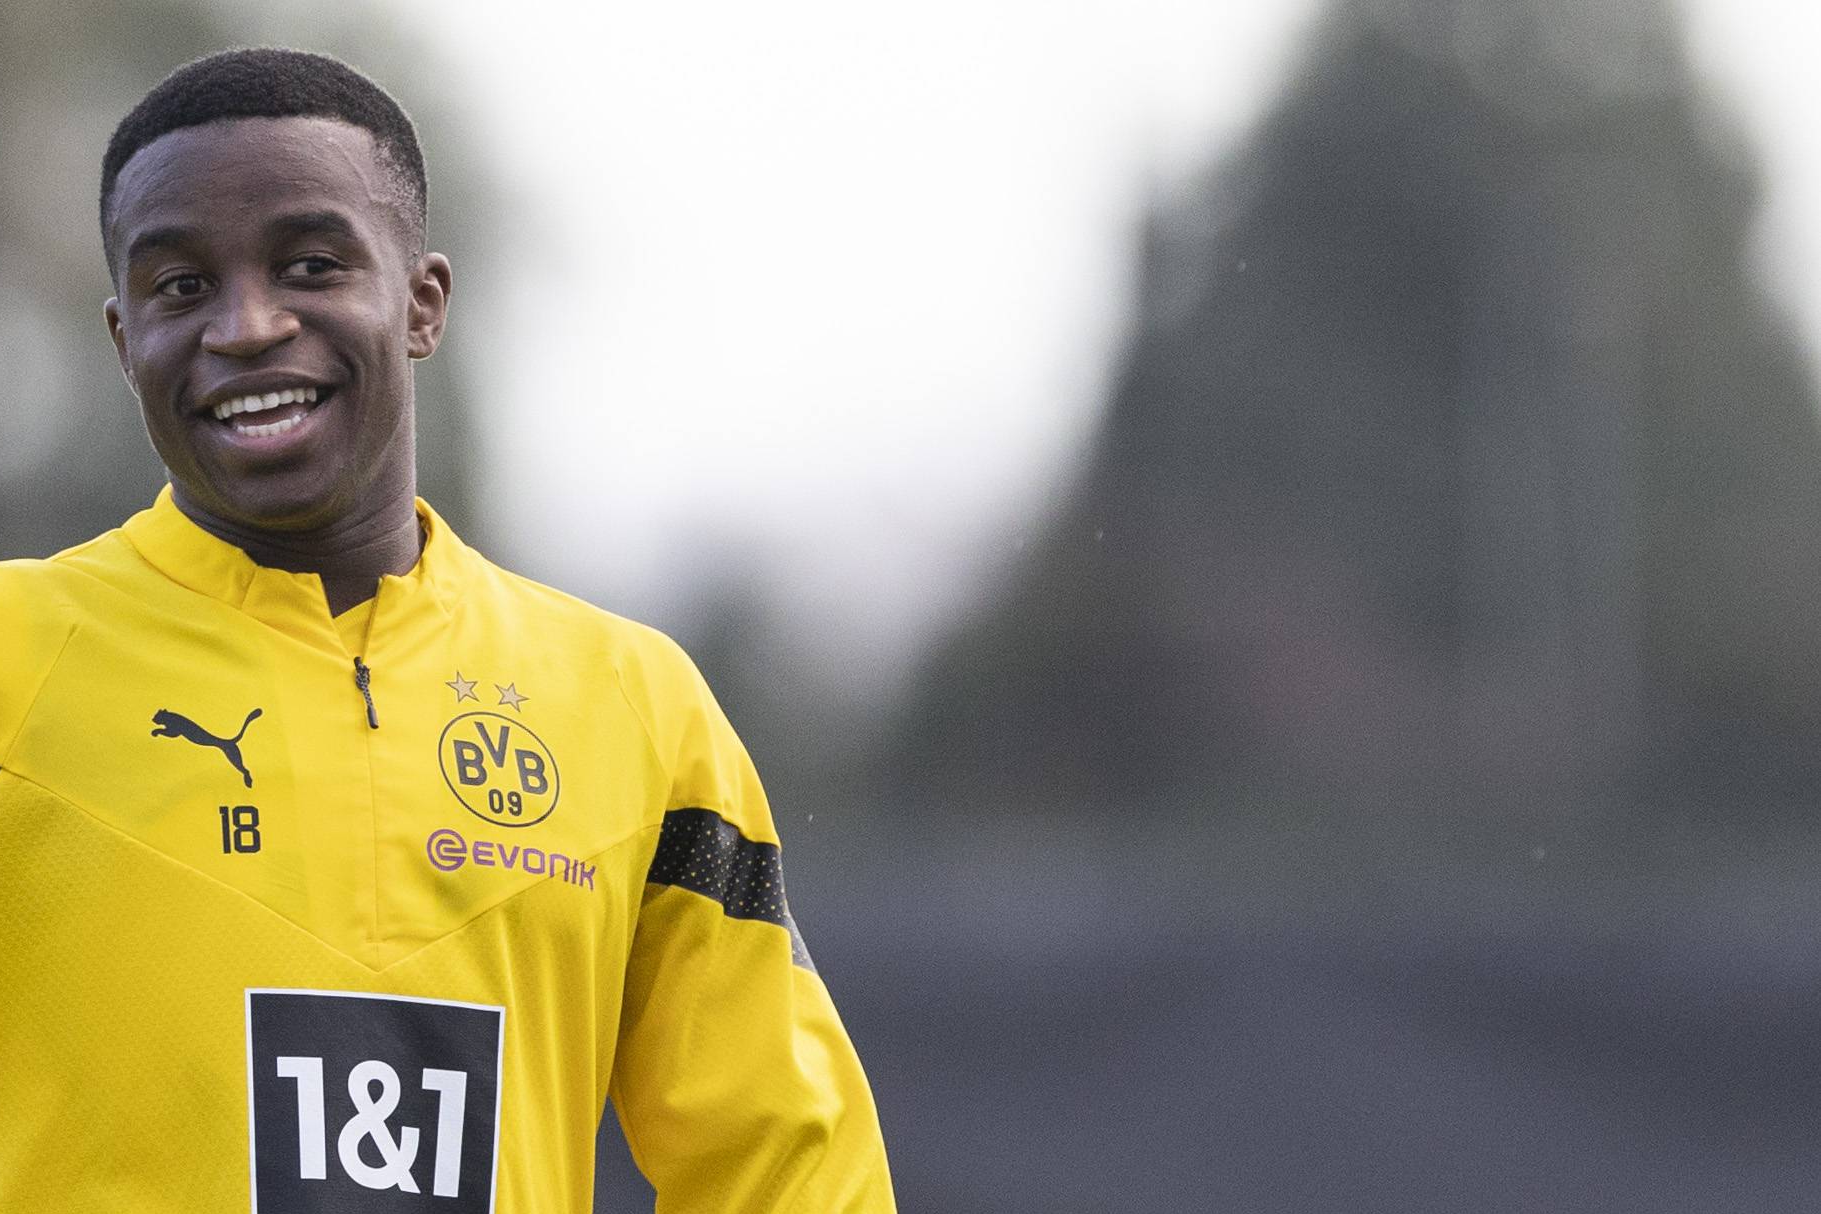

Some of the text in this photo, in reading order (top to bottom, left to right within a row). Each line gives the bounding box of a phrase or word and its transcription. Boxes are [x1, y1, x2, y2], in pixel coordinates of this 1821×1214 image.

[453, 721, 549, 796] BVB
[488, 788, 523, 817] 09
[219, 805, 261, 854] 18
[472, 840, 597, 891] EVONIK
[277, 1056, 467, 1198] 1&1
